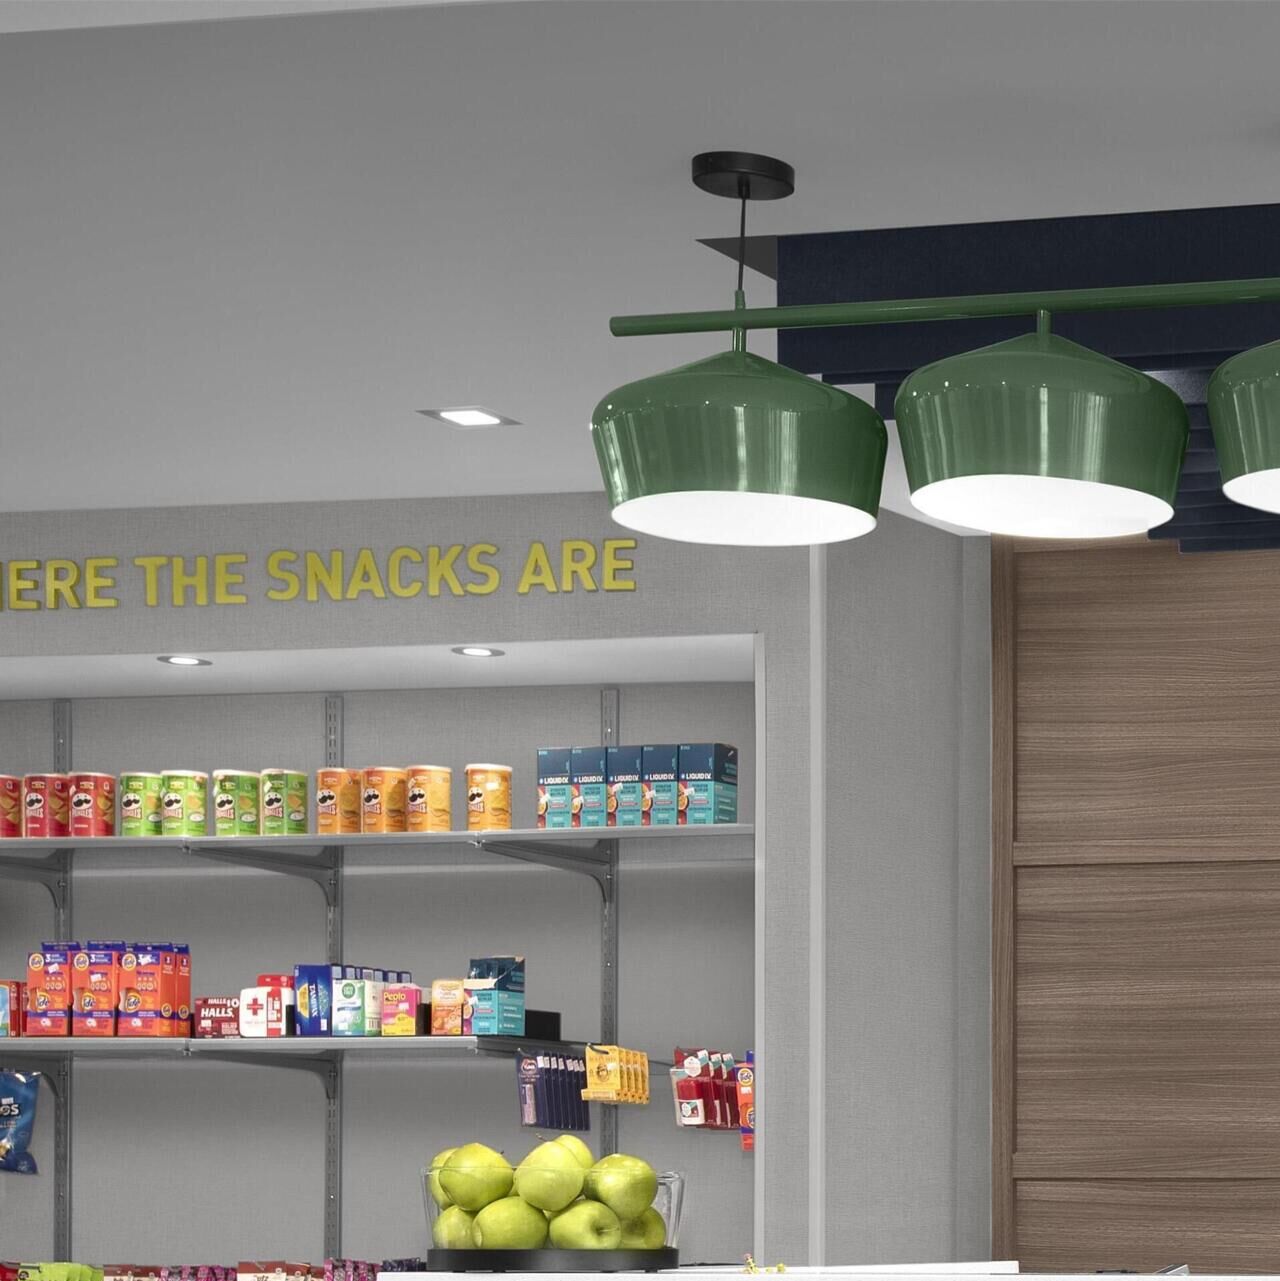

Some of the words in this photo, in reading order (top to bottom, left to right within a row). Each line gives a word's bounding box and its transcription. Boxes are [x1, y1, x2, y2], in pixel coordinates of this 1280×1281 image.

[0, 558, 119, 611] ERE
[133, 554, 248, 607] THE
[266, 543, 501, 601] SNACKS
[516, 538, 637, 595] ARE
